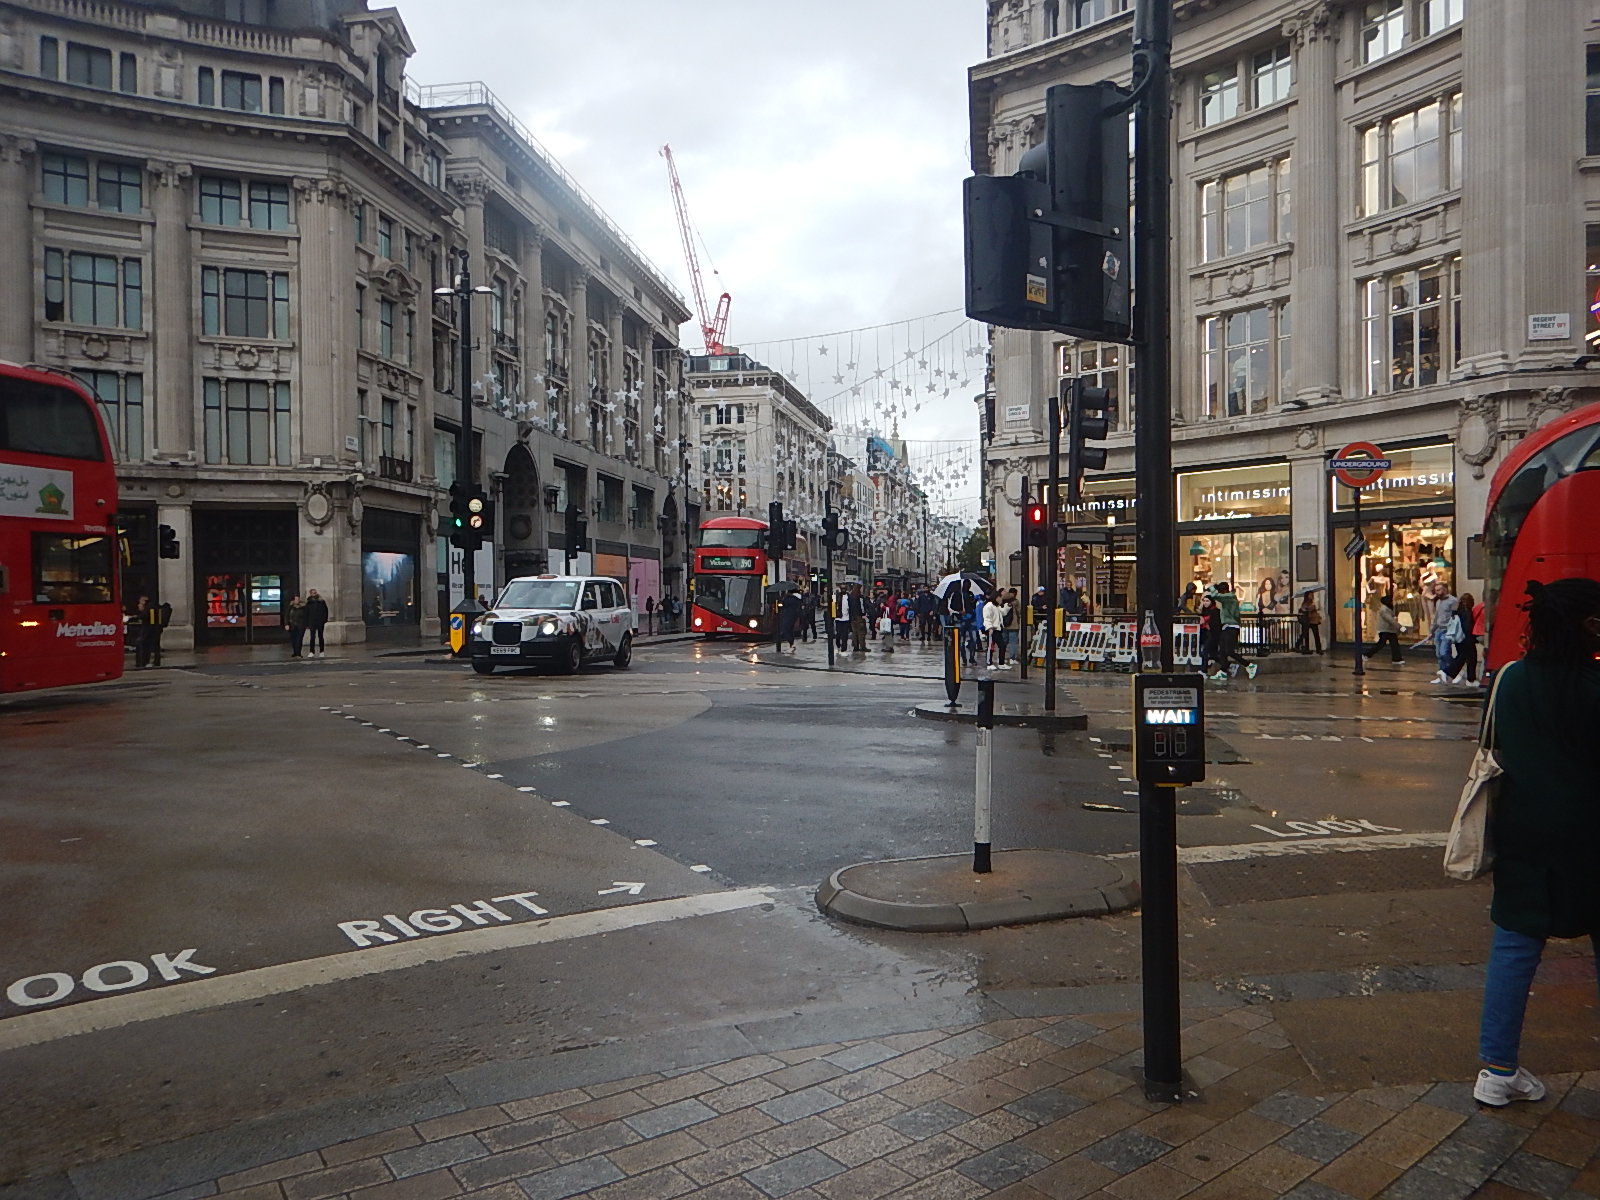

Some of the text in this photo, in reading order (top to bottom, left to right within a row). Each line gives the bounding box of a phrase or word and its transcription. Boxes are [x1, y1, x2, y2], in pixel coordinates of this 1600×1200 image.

[1332, 460, 1389, 468] UNDERGROUND
[740, 558, 752, 569] 390
[56, 621, 117, 638] Metroline
[1147, 709, 1192, 724] WAIT
[1250, 819, 1402, 837] LOOK
[337, 891, 549, 947] RIGHT
[6, 948, 217, 1008] OOK
